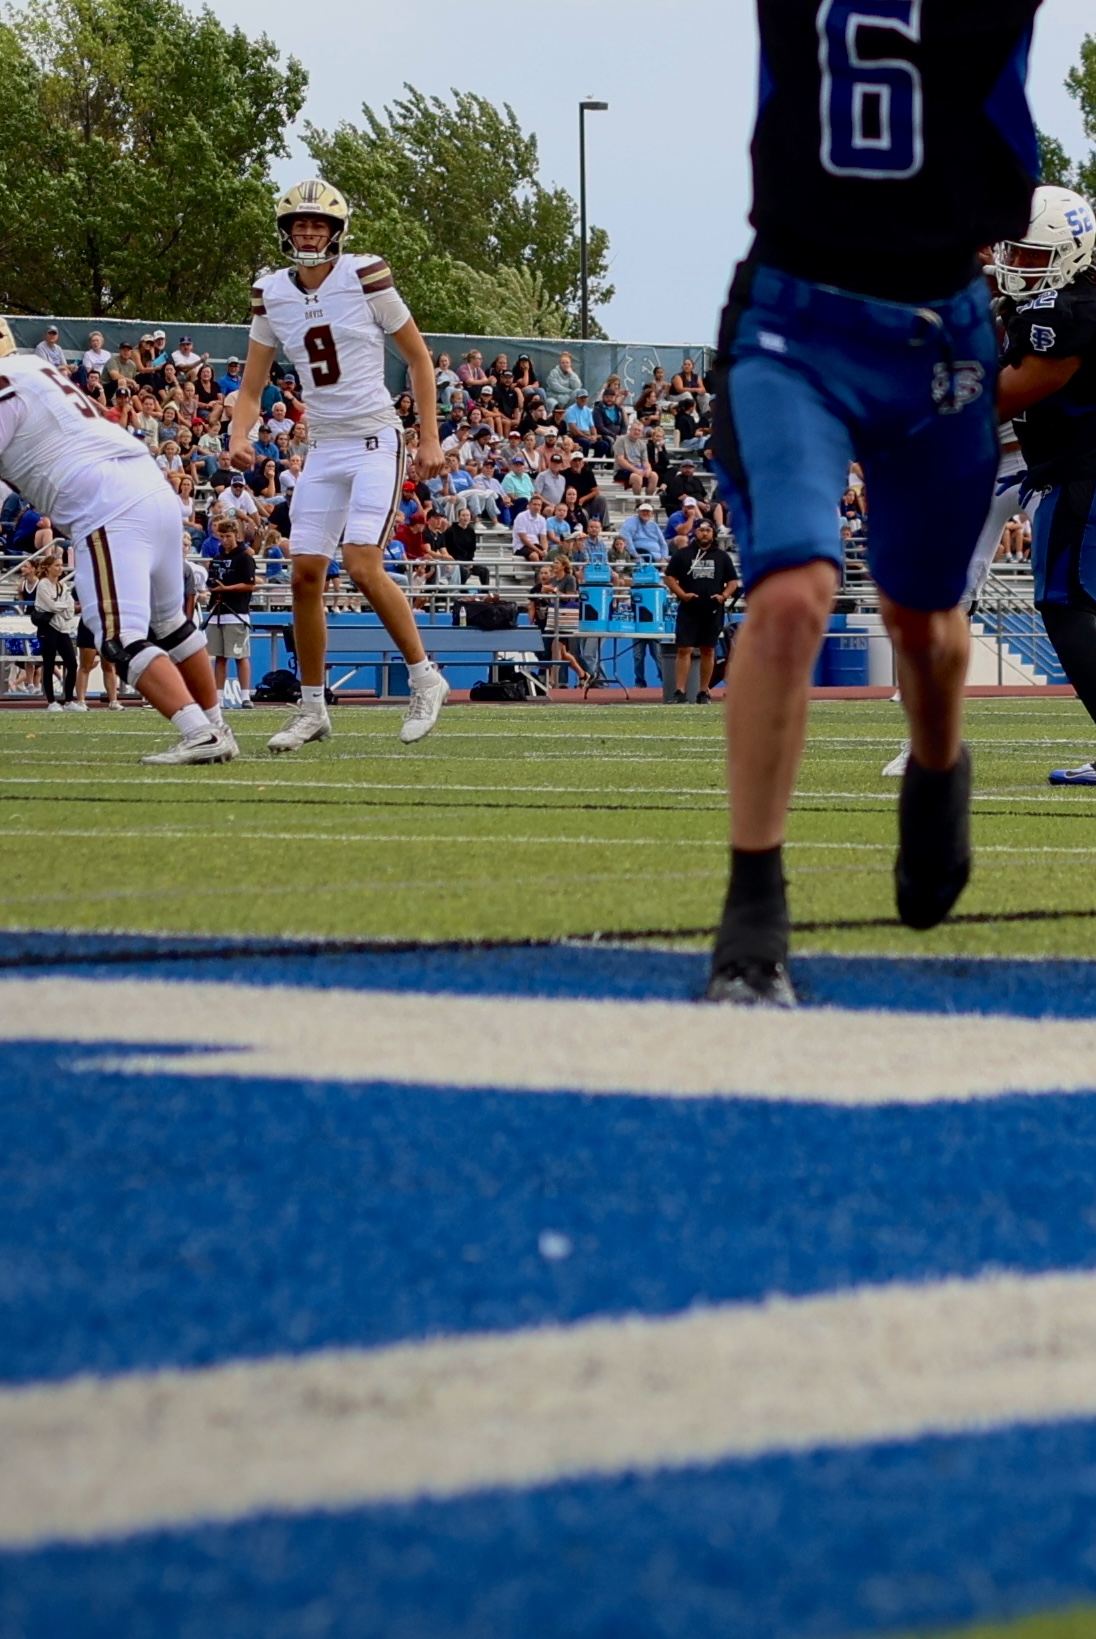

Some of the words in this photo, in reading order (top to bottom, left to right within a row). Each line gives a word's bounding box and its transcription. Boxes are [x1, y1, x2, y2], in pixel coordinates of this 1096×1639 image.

[1064, 207, 1094, 237] 52
[305, 309, 323, 320] DAVIS
[303, 323, 341, 388] 9
